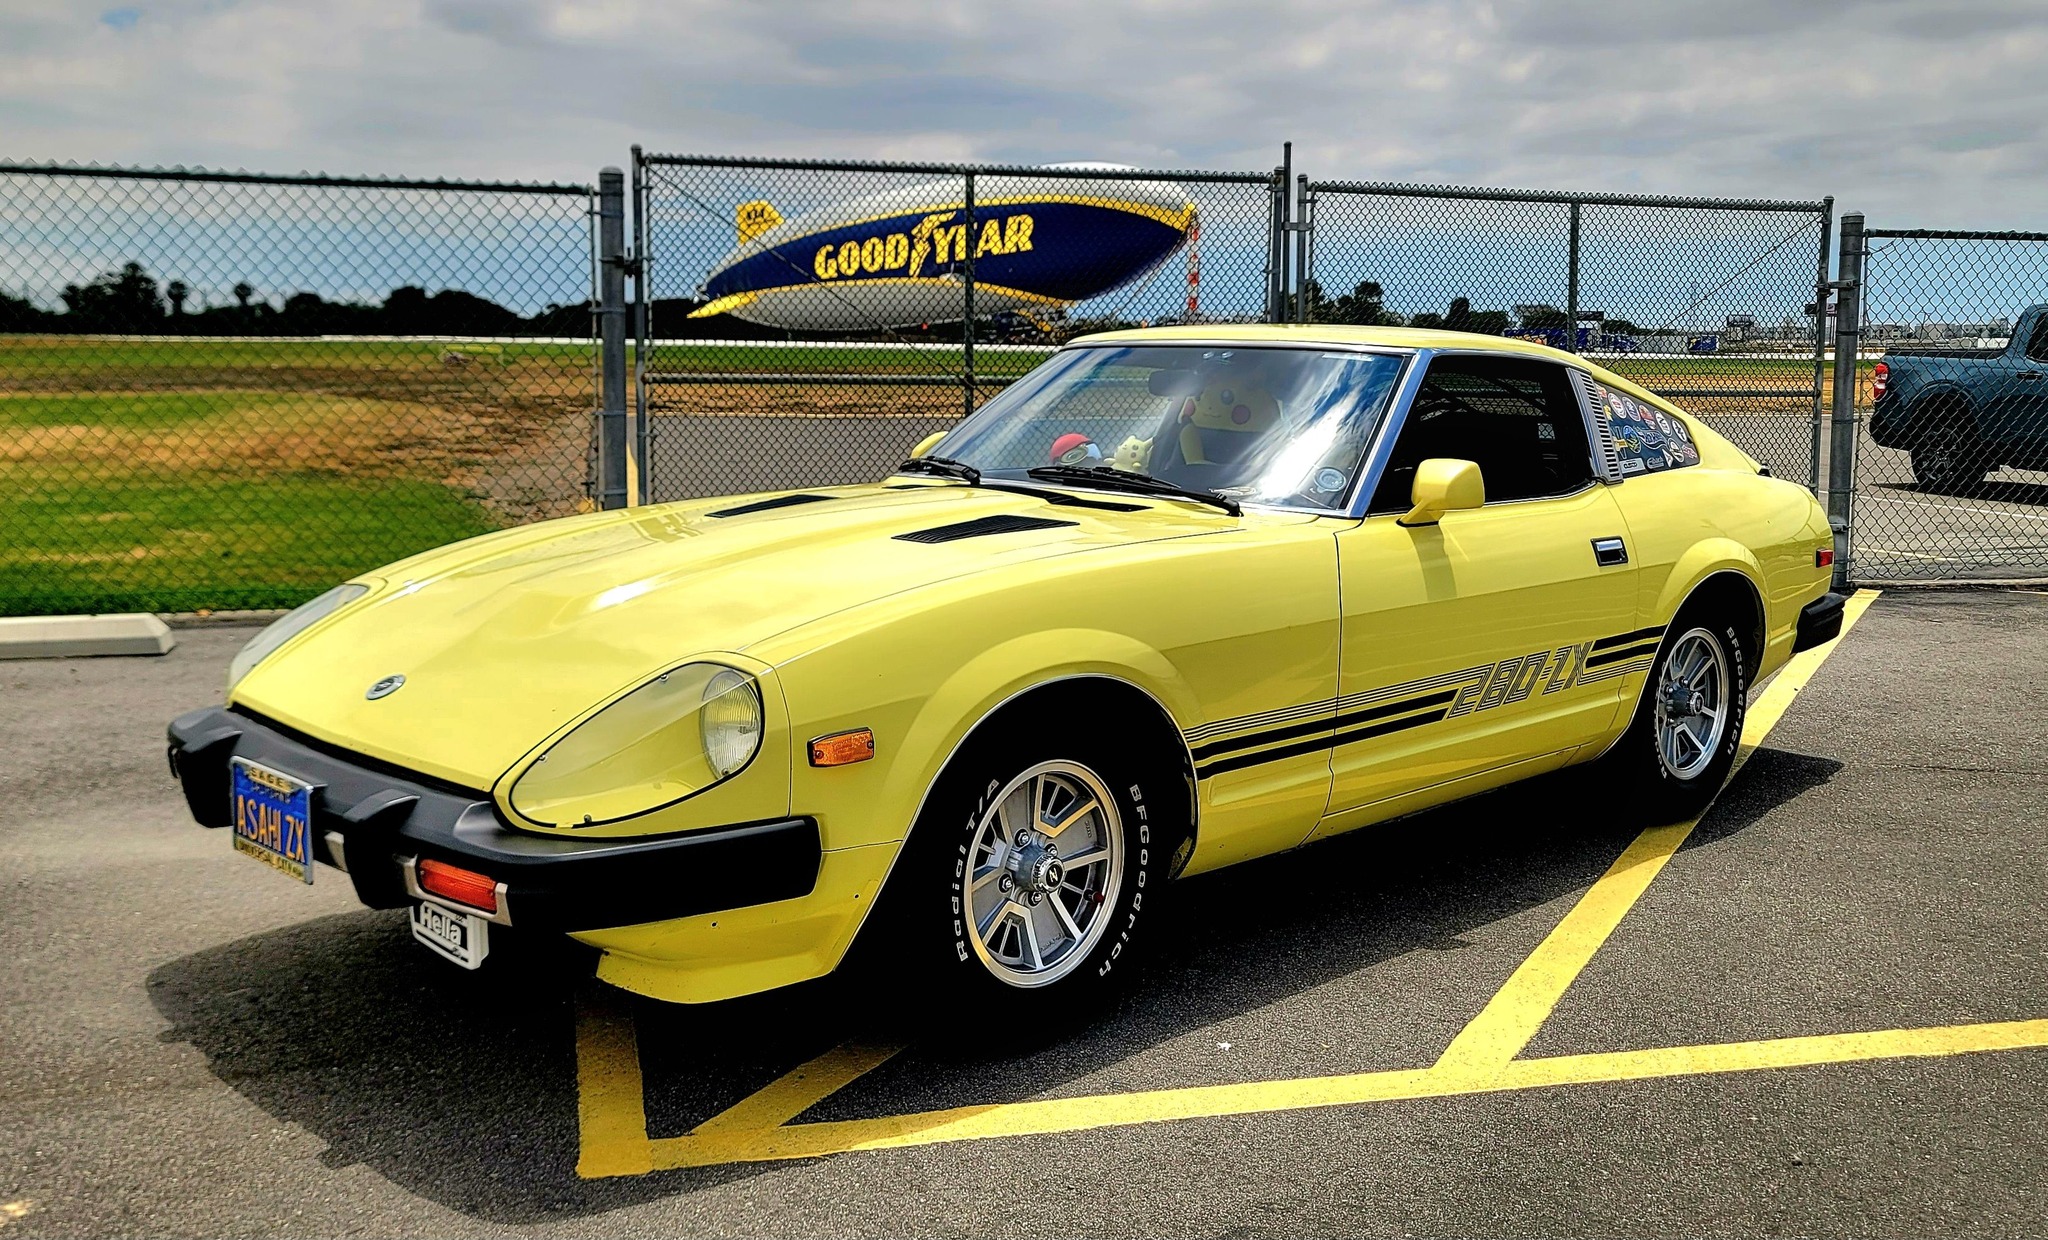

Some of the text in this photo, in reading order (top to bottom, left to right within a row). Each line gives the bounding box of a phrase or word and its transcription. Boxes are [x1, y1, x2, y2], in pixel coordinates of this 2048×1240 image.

[237, 794, 306, 863] ASAHI ZX
[420, 904, 462, 947] Hella
[951, 844, 969, 962] Radial
[1099, 783, 1150, 977] BFGoodrich
